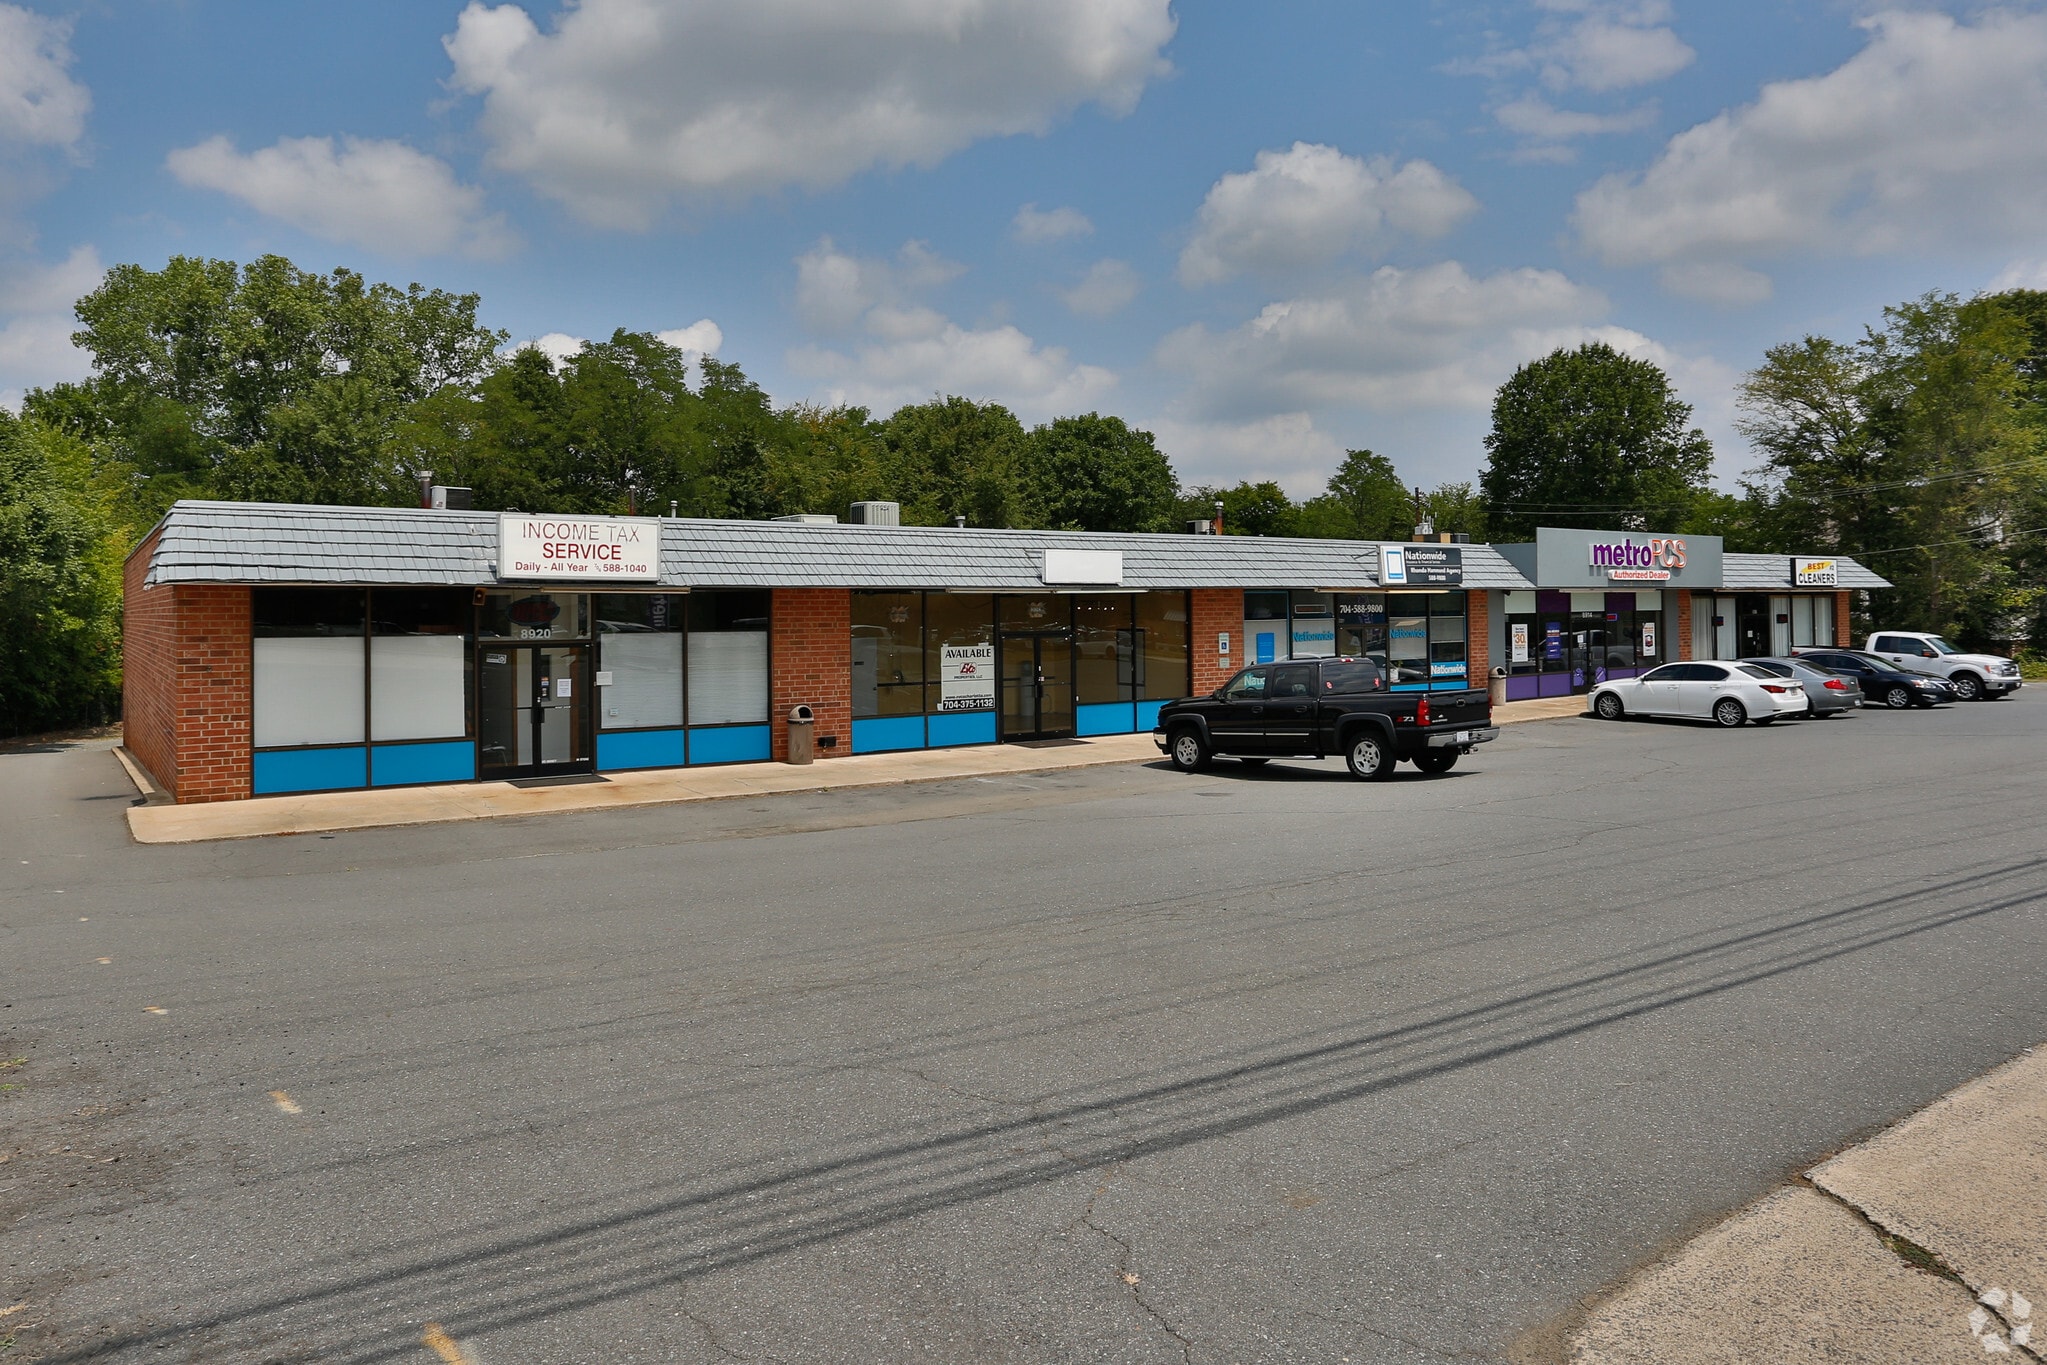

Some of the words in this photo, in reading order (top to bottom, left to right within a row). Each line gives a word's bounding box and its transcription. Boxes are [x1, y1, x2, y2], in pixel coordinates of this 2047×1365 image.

[523, 521, 600, 540] INCOME
[606, 525, 639, 543] TAX
[543, 543, 622, 560] SERVICE
[1405, 550, 1446, 560] Nationwide
[1592, 539, 1687, 568] metroPCS
[515, 562, 541, 573] Daily
[550, 562, 565, 571] All
[567, 563, 588, 571] Year
[603, 563, 647, 573] 588-1040
[1614, 571, 1648, 579] Authorized
[1649, 571, 1670, 579] Dealer
[1799, 573, 1835, 584] CLEANERS
[1340, 605, 1383, 613] 704-588-9800
[520, 629, 551, 639] 8920
[1293, 631, 1334, 642] Nationwide
[1390, 628, 1427, 639] Nationwide
[945, 649, 991, 658] AVAILABLE
[1431, 664, 1467, 675] Nationwide
[944, 699, 993, 708] 704-375-1132
